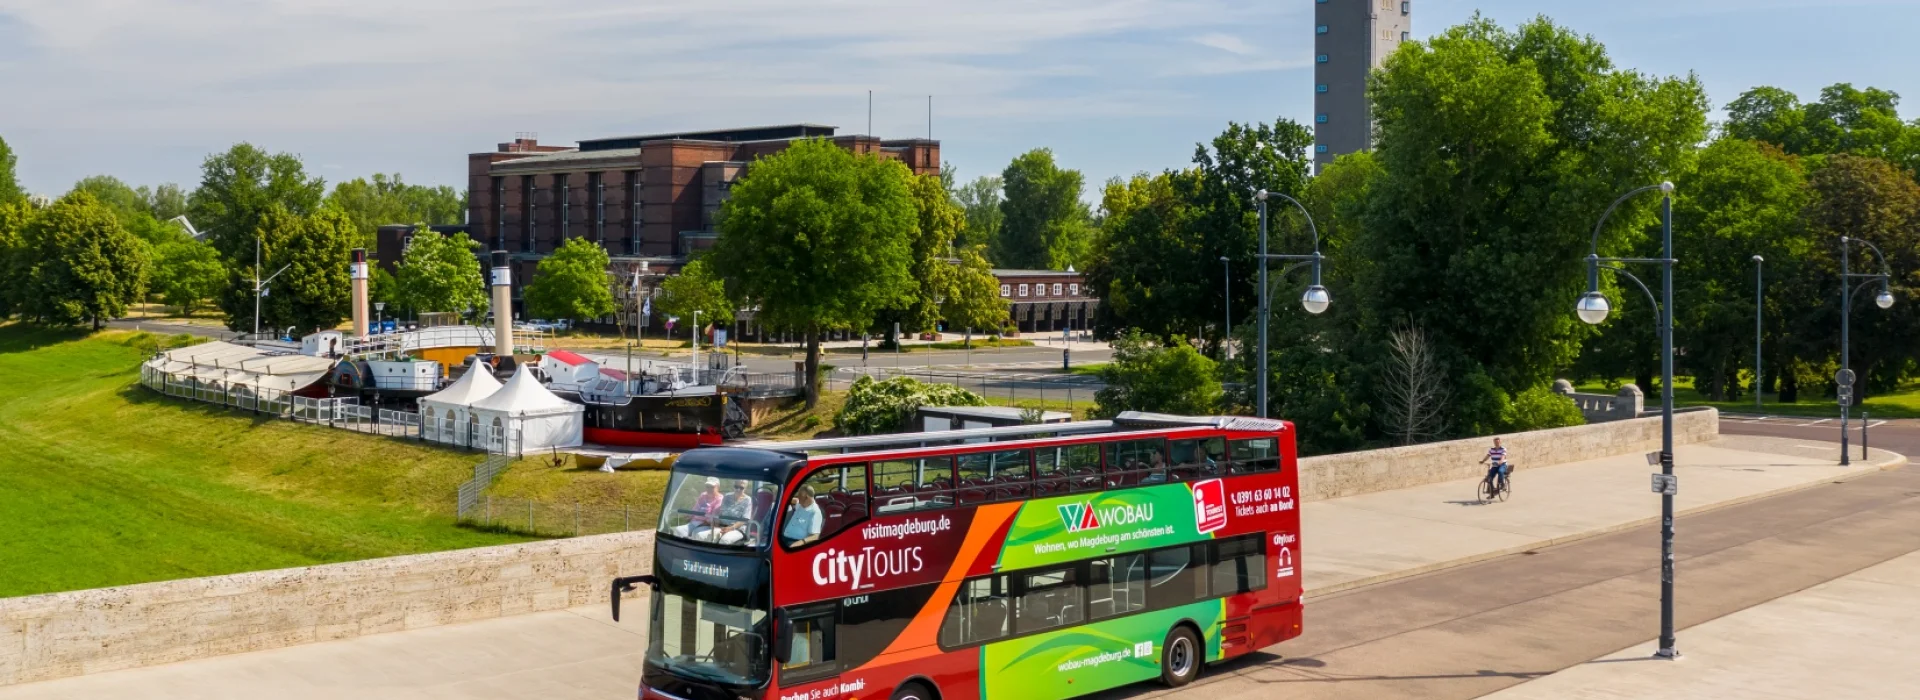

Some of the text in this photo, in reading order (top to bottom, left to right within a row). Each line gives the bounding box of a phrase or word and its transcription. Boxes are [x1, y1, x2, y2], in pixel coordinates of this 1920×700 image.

[1237, 485, 1291, 504] 0391 63 60 14 02
[1099, 502, 1154, 527] WOBAU
[1235, 504, 1254, 517] Tickets
[862, 514, 951, 540] visitmagdeburg.de
[1034, 524, 1175, 555] Wohnen, wo Magdeburg am schönsten ist.
[683, 560, 729, 578] Stadtrundfahrt
[812, 546, 923, 590] CityTours
[1058, 647, 1131, 672] wobau-magdeburg.de
[810, 689, 821, 700] Sie
[822, 684, 839, 697] auch
[840, 678, 866, 693] Kombi-
